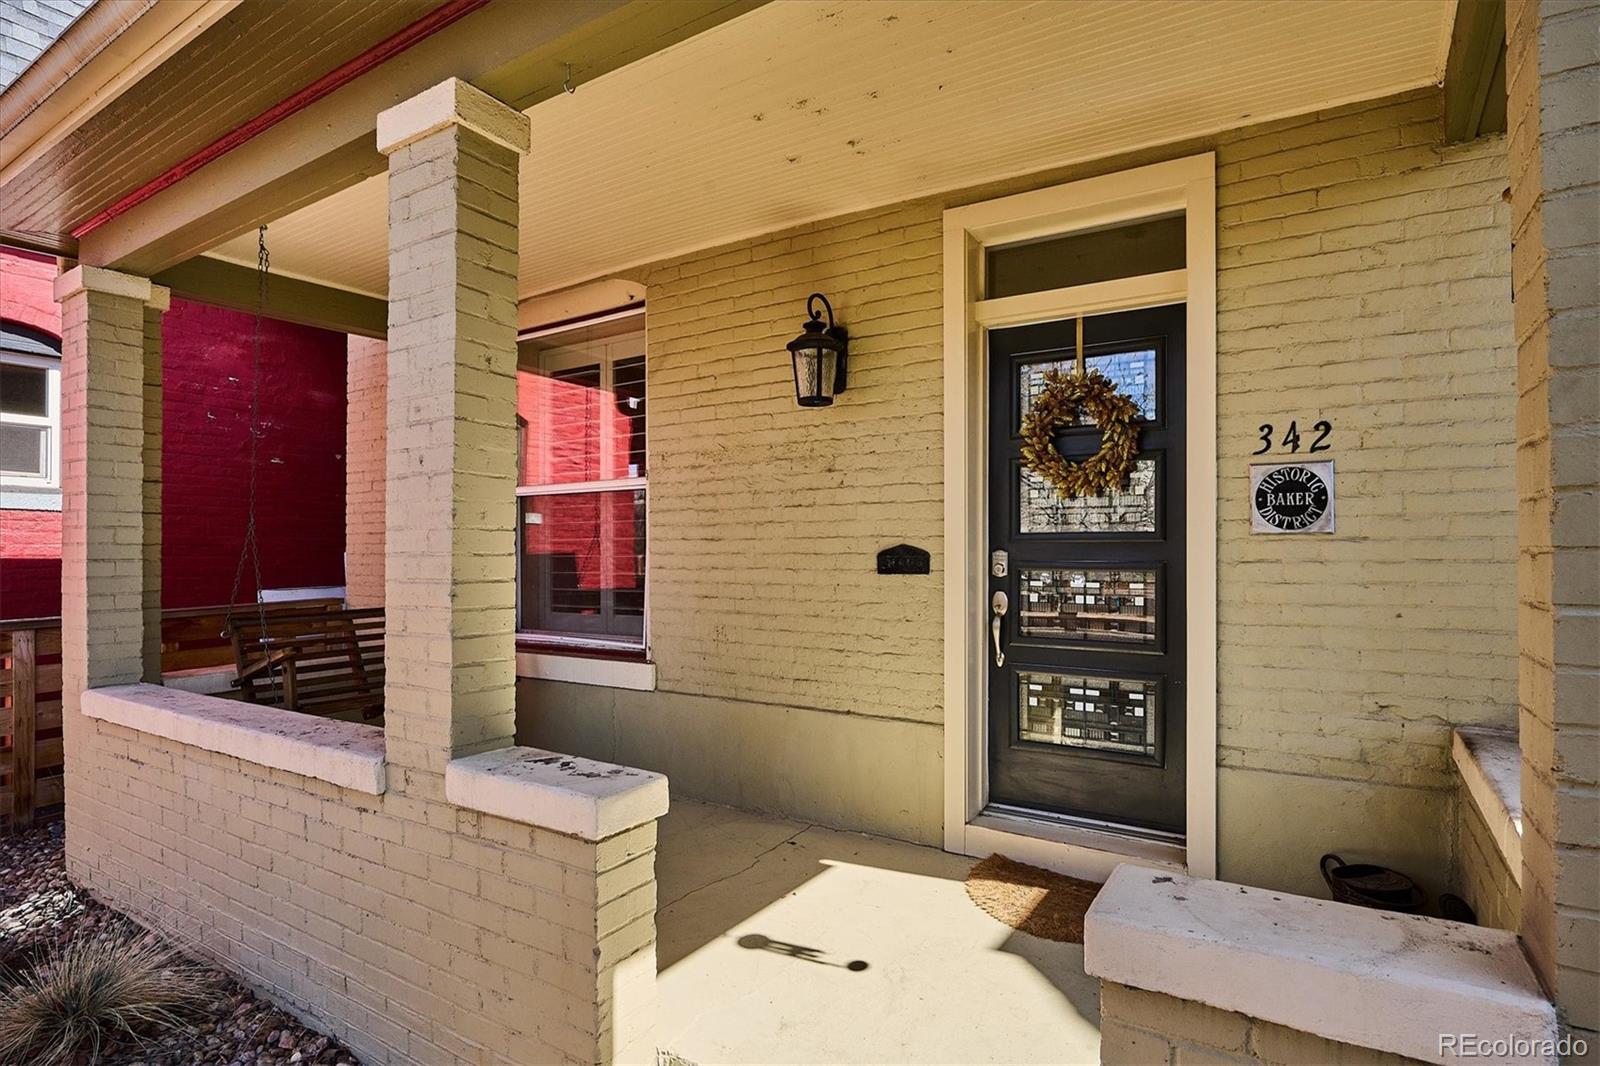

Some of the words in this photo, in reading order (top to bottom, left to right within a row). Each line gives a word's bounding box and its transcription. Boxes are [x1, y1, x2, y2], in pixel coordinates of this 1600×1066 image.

[1253, 420, 1332, 455] 342
[1259, 467, 1325, 493] HISTORIC
[1266, 491, 1315, 506] BAKER
[1259, 504, 1323, 529] DISTRICT
